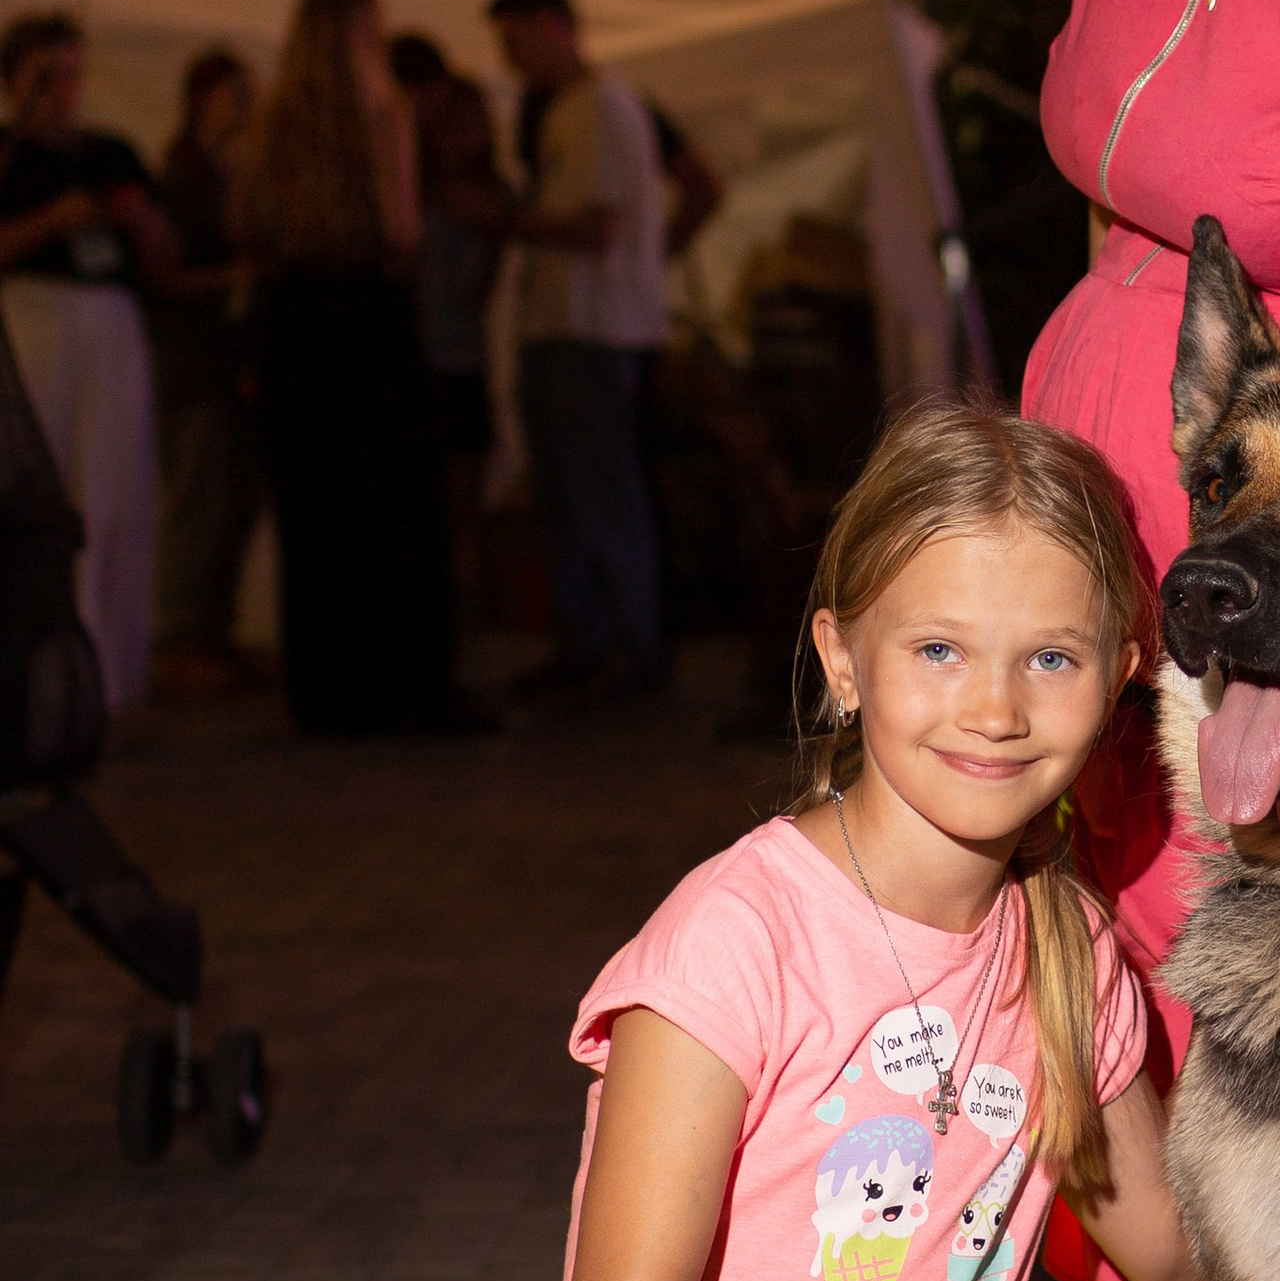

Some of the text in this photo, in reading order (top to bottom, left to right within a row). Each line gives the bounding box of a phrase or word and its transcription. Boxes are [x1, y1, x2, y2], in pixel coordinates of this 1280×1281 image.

[873, 1022, 944, 1059] You make
[883, 1060, 903, 1075] me
[973, 1076, 996, 1099] You
[970, 1102, 982, 1114] so
